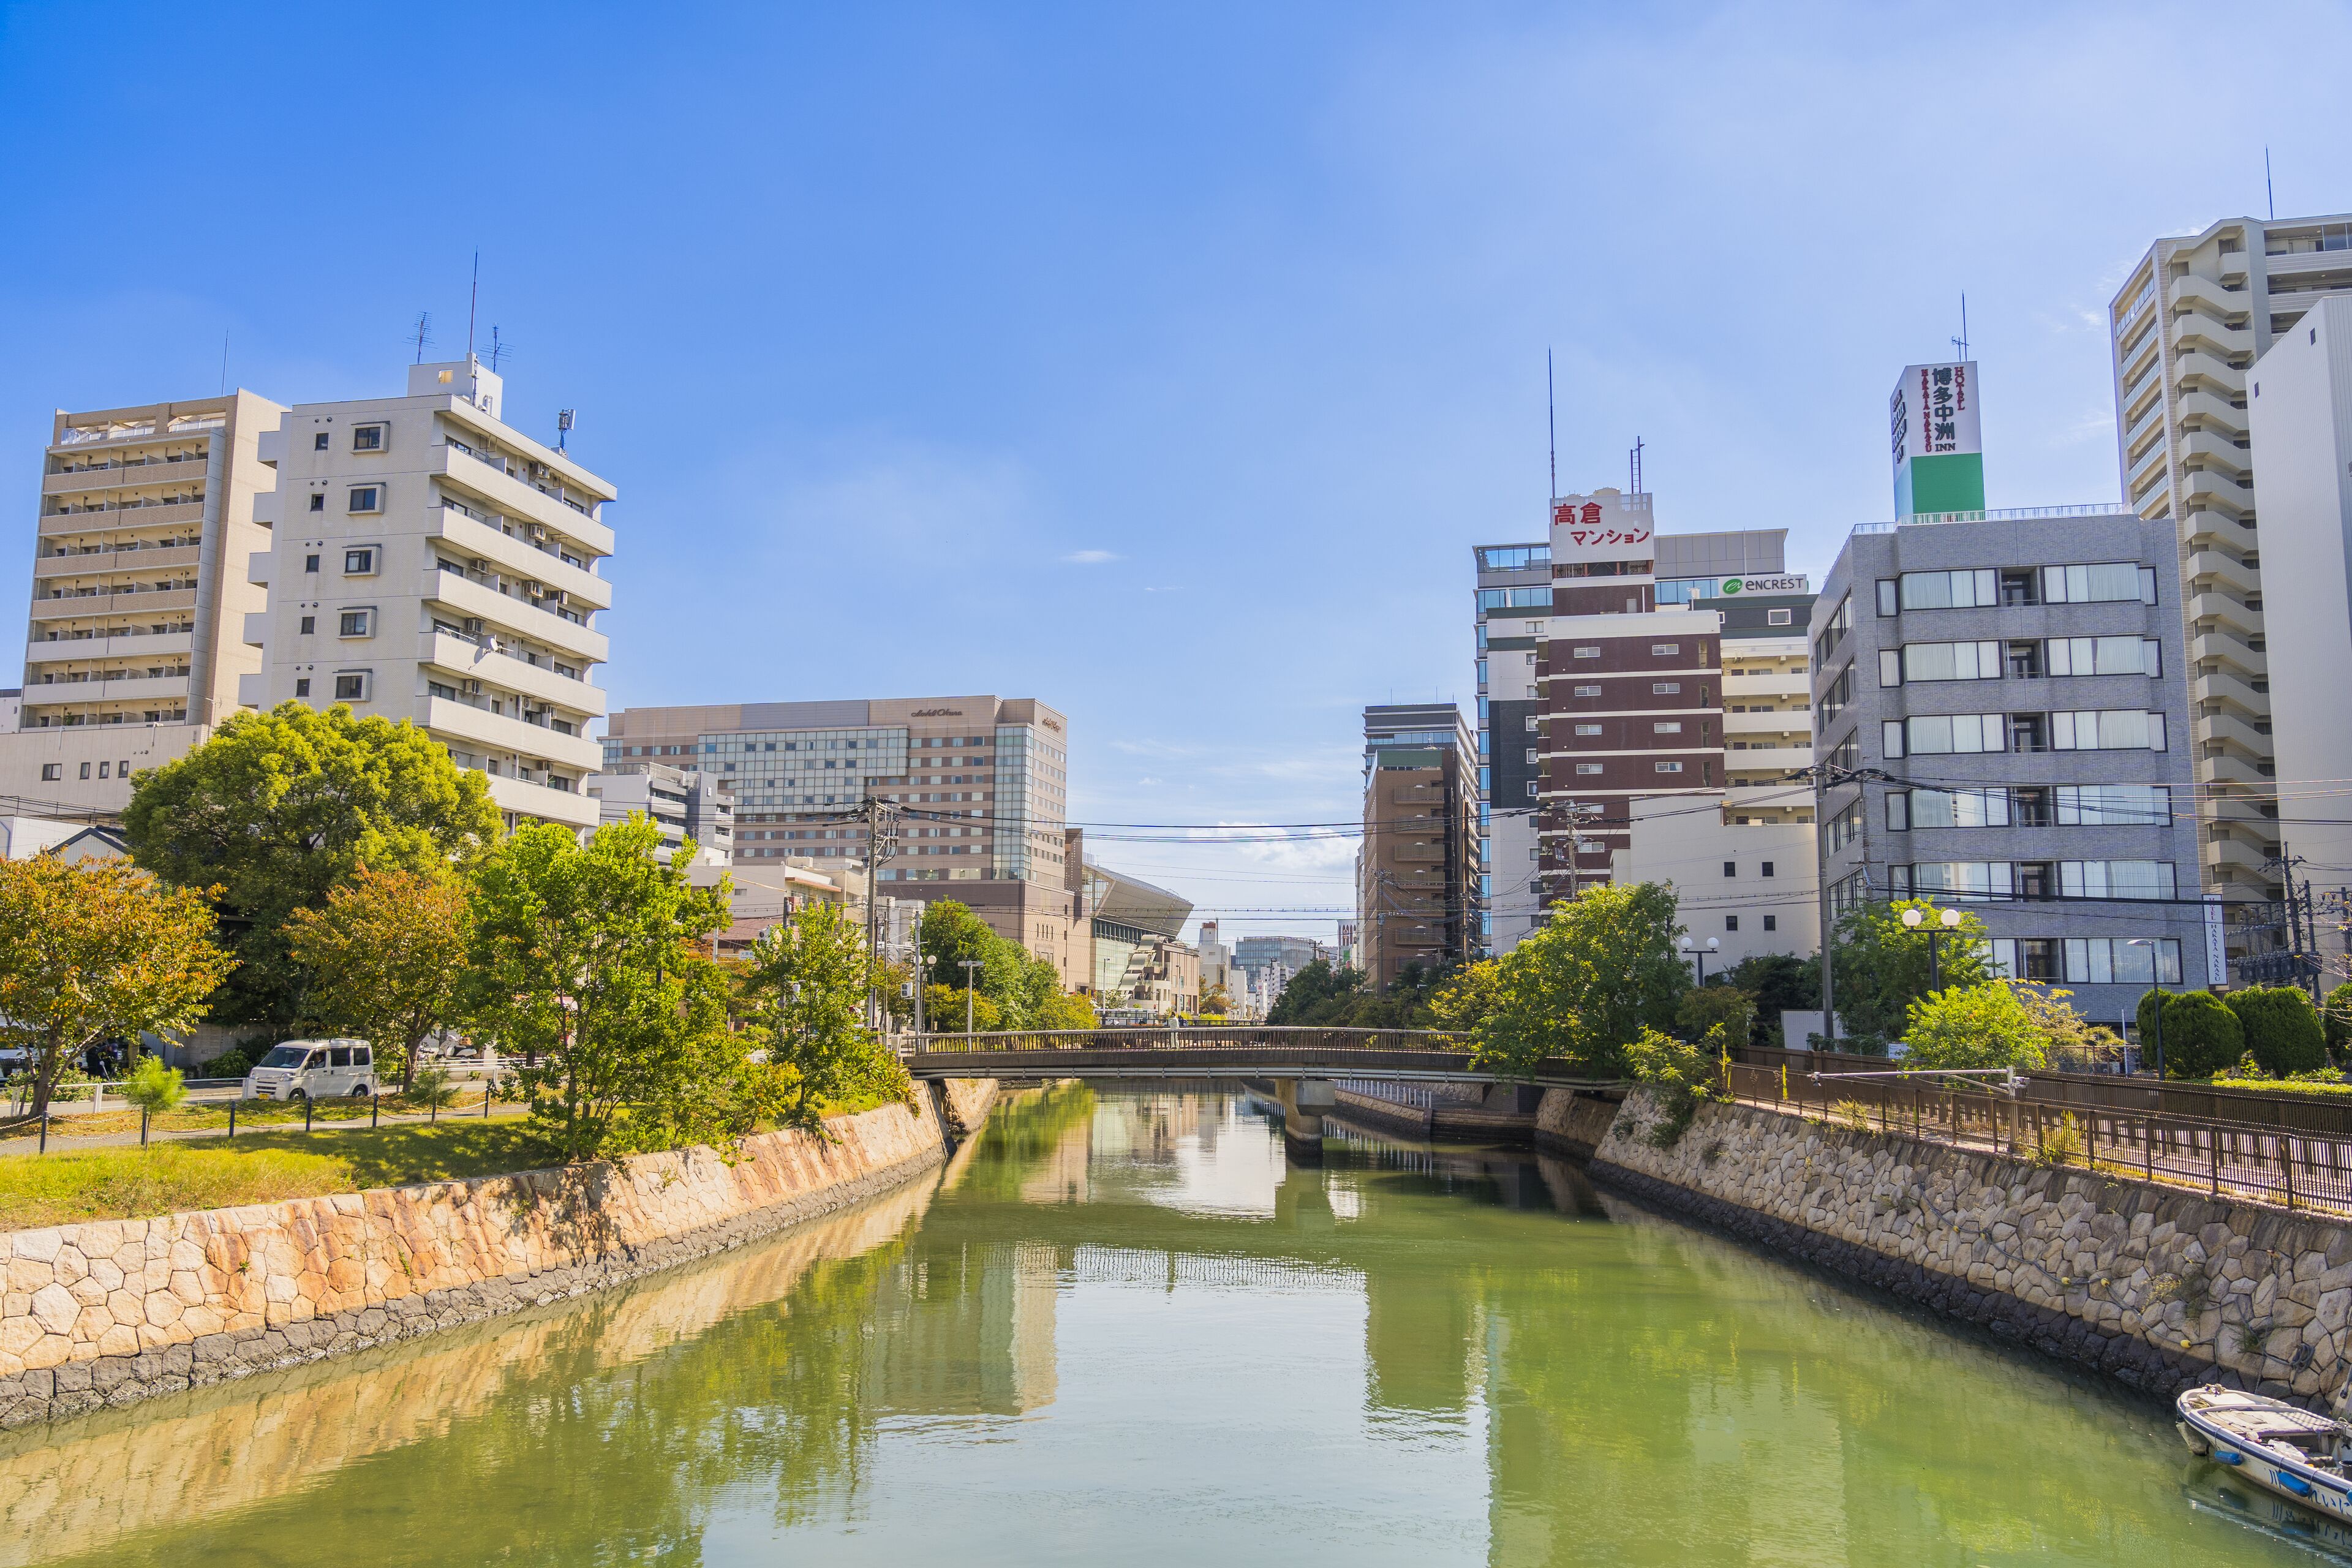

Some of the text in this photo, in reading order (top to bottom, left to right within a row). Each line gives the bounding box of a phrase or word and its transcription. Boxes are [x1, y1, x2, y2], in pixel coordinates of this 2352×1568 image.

[1954, 366, 1965, 411] HOTEL
[1932, 367, 1955, 441] 博多中洲
[1923, 411, 1932, 453] NAKASU
[1935, 443, 1956, 452] INN
[1553, 502, 1602, 526] 高倉
[1570, 528, 1649, 546] マンション
[937, 708, 963, 717] Okura
